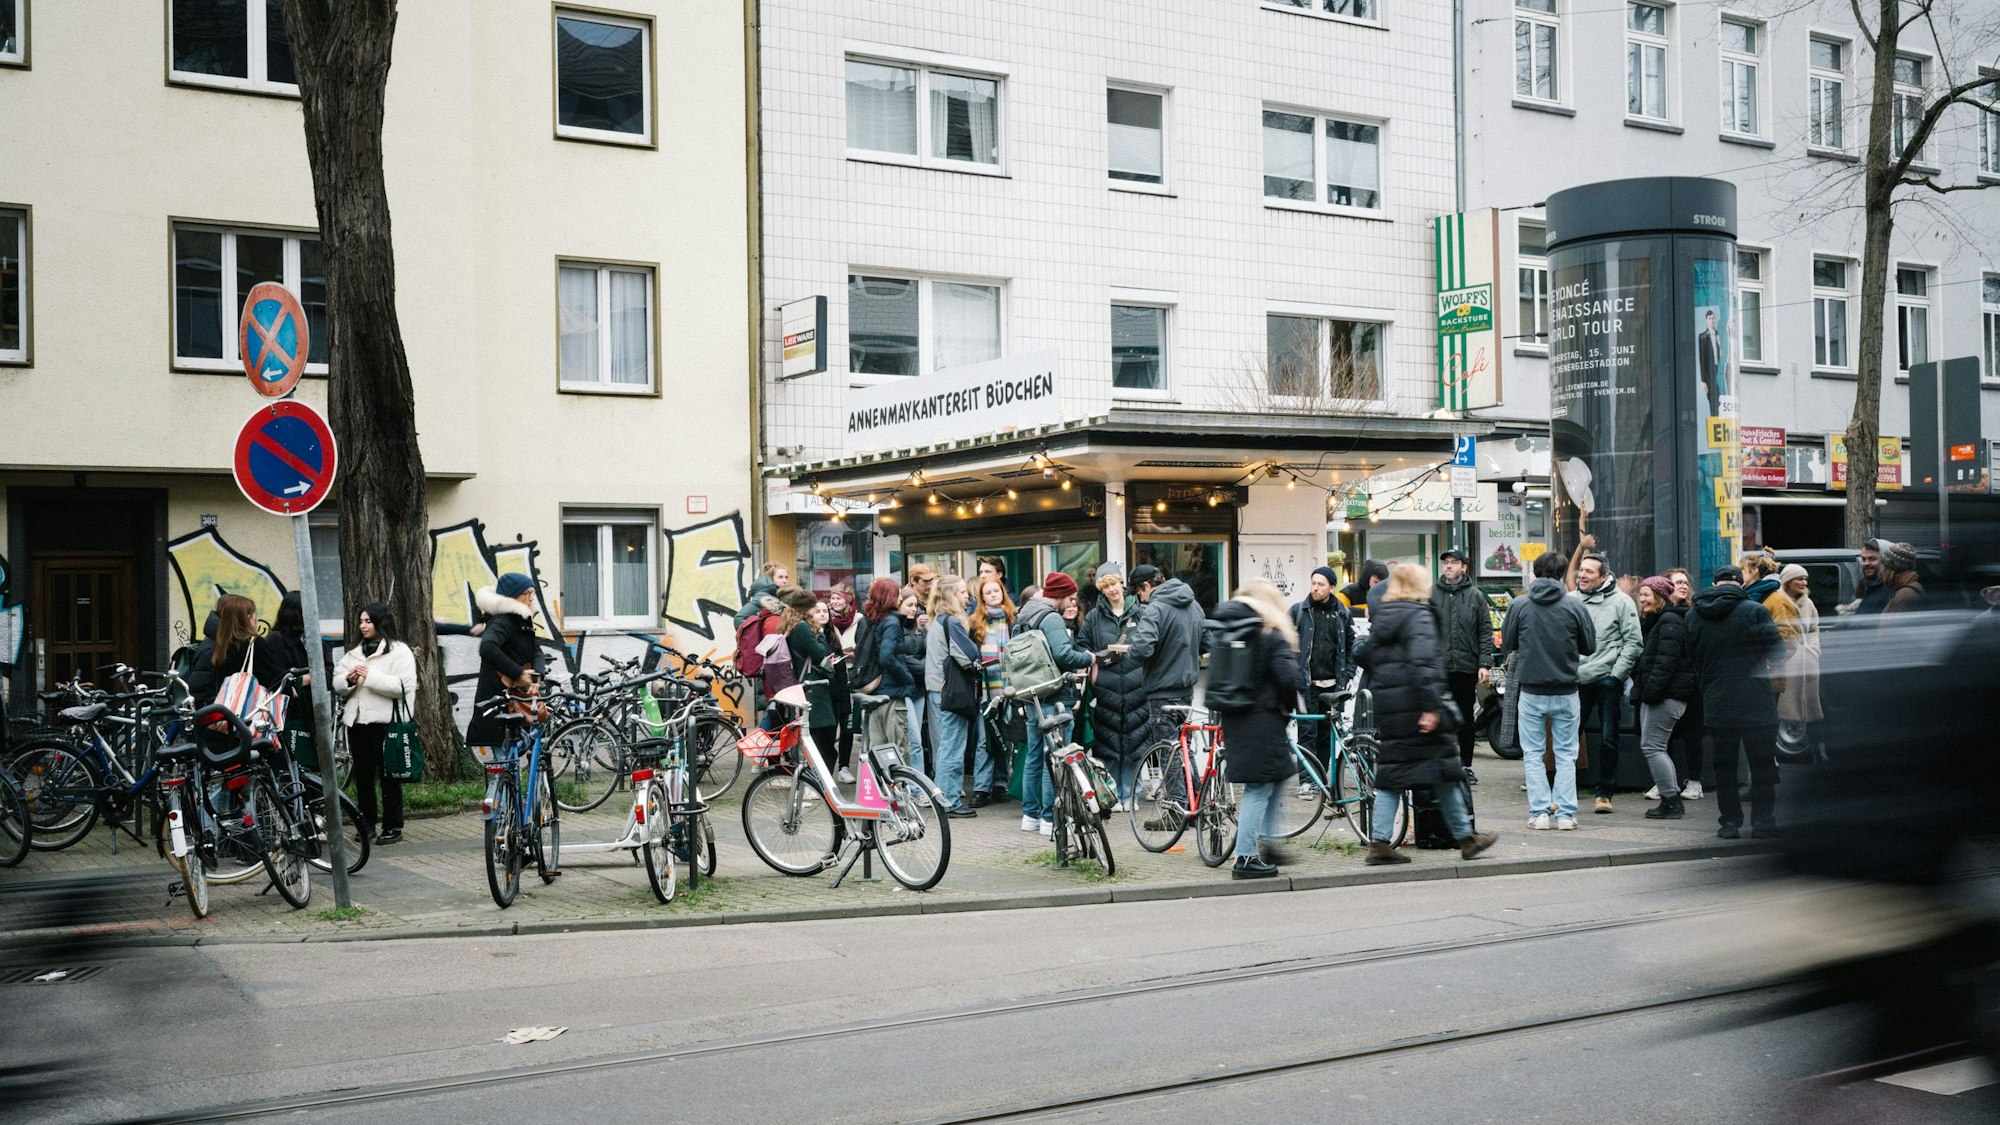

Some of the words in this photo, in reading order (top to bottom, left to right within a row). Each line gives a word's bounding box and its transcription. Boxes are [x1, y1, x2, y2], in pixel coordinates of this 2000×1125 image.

[1693, 214, 1726, 227] STRÖER
[1441, 290, 1488, 312] WOLFF'S
[1441, 313, 1488, 326] BACKSTUBE
[1582, 319, 1623, 336] TOUR
[1610, 345, 1635, 355] JUNI
[1442, 346, 1490, 394] Café
[848, 386, 980, 434] ANNENMAYKANTEREIT
[986, 371, 1053, 409] BÜDCHEN
